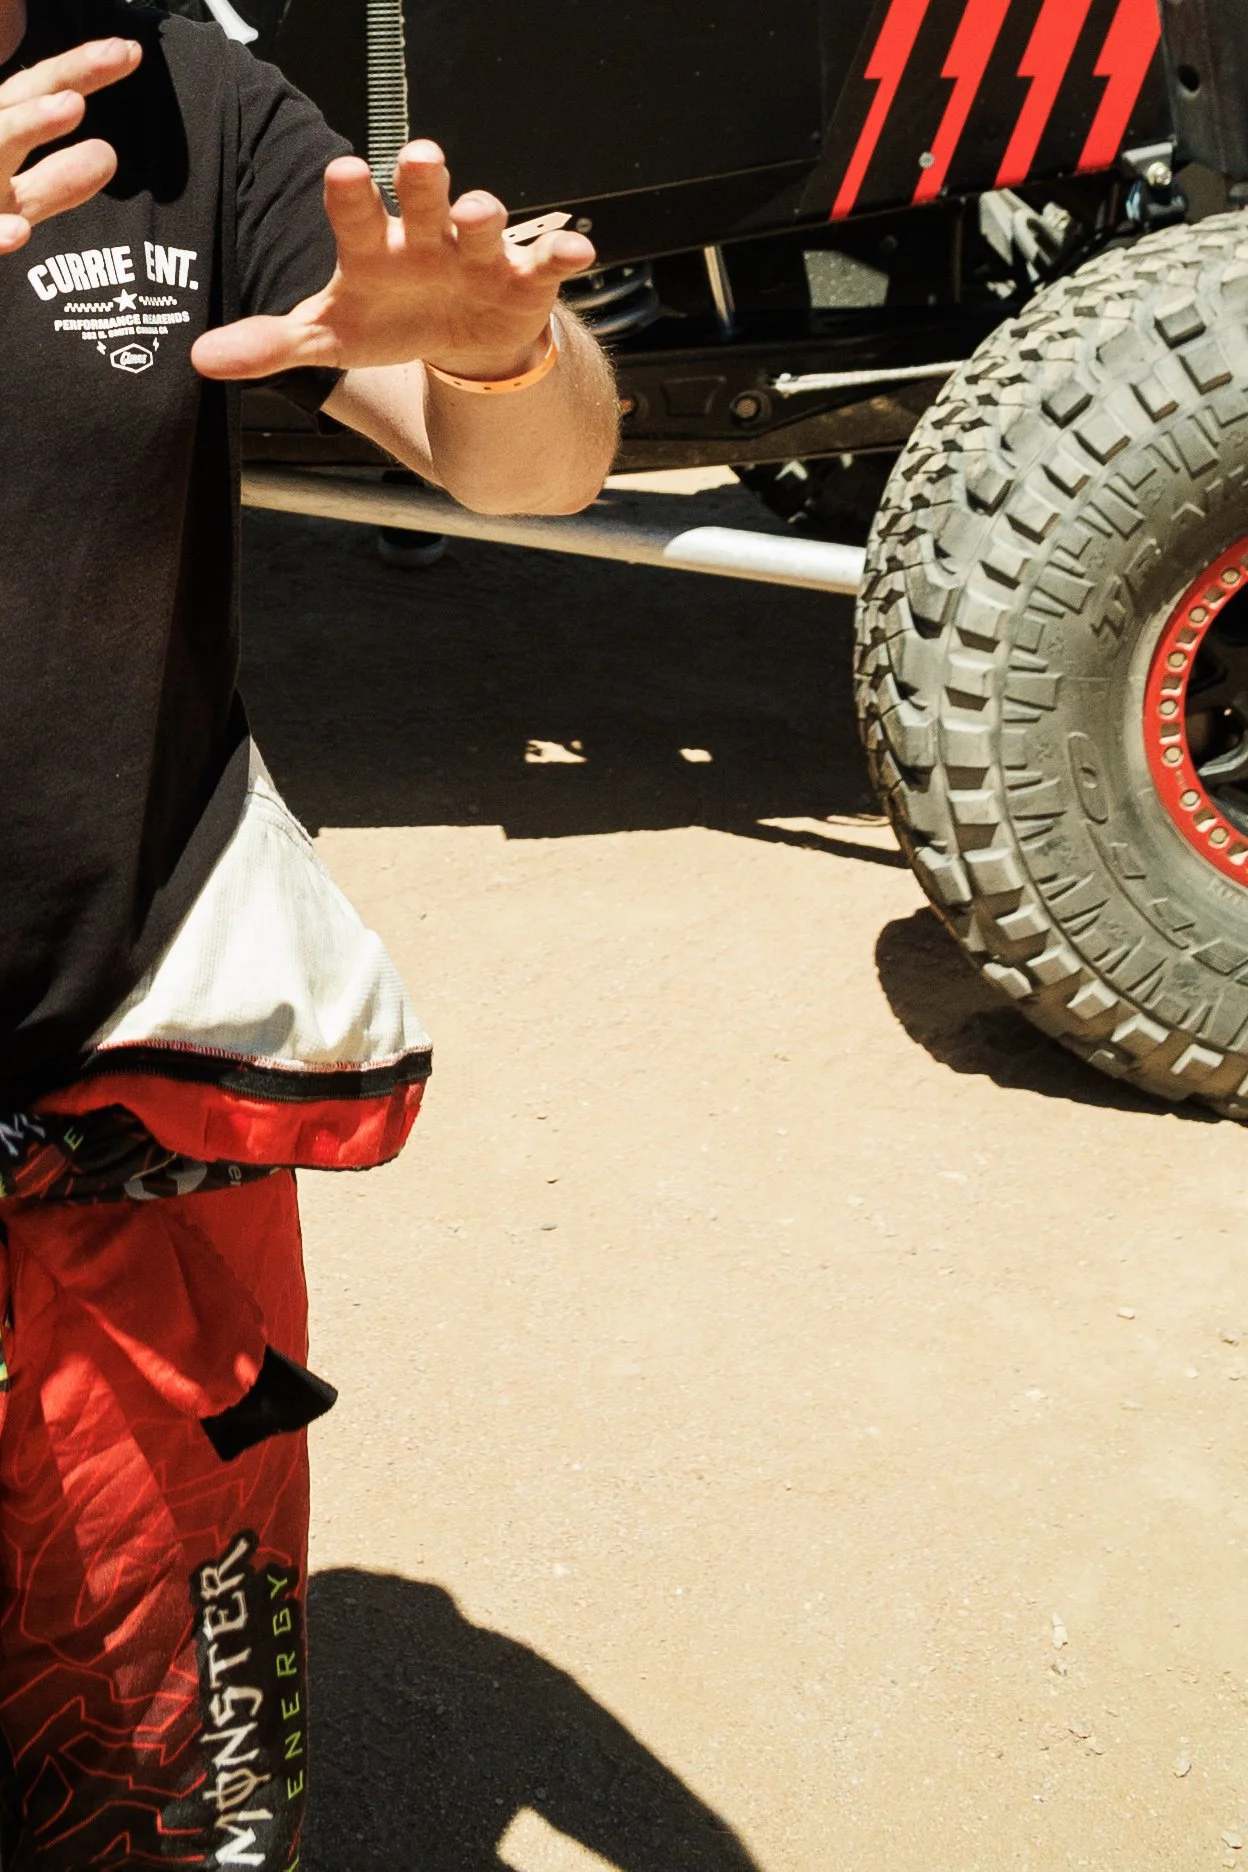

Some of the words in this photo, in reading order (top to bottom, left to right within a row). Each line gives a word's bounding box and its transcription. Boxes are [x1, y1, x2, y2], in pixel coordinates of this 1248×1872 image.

[27, 246, 135, 301] CURRIE
[54, 314, 141, 331] PERFORMANCE
[267, 1574, 303, 1800] ENERGY
